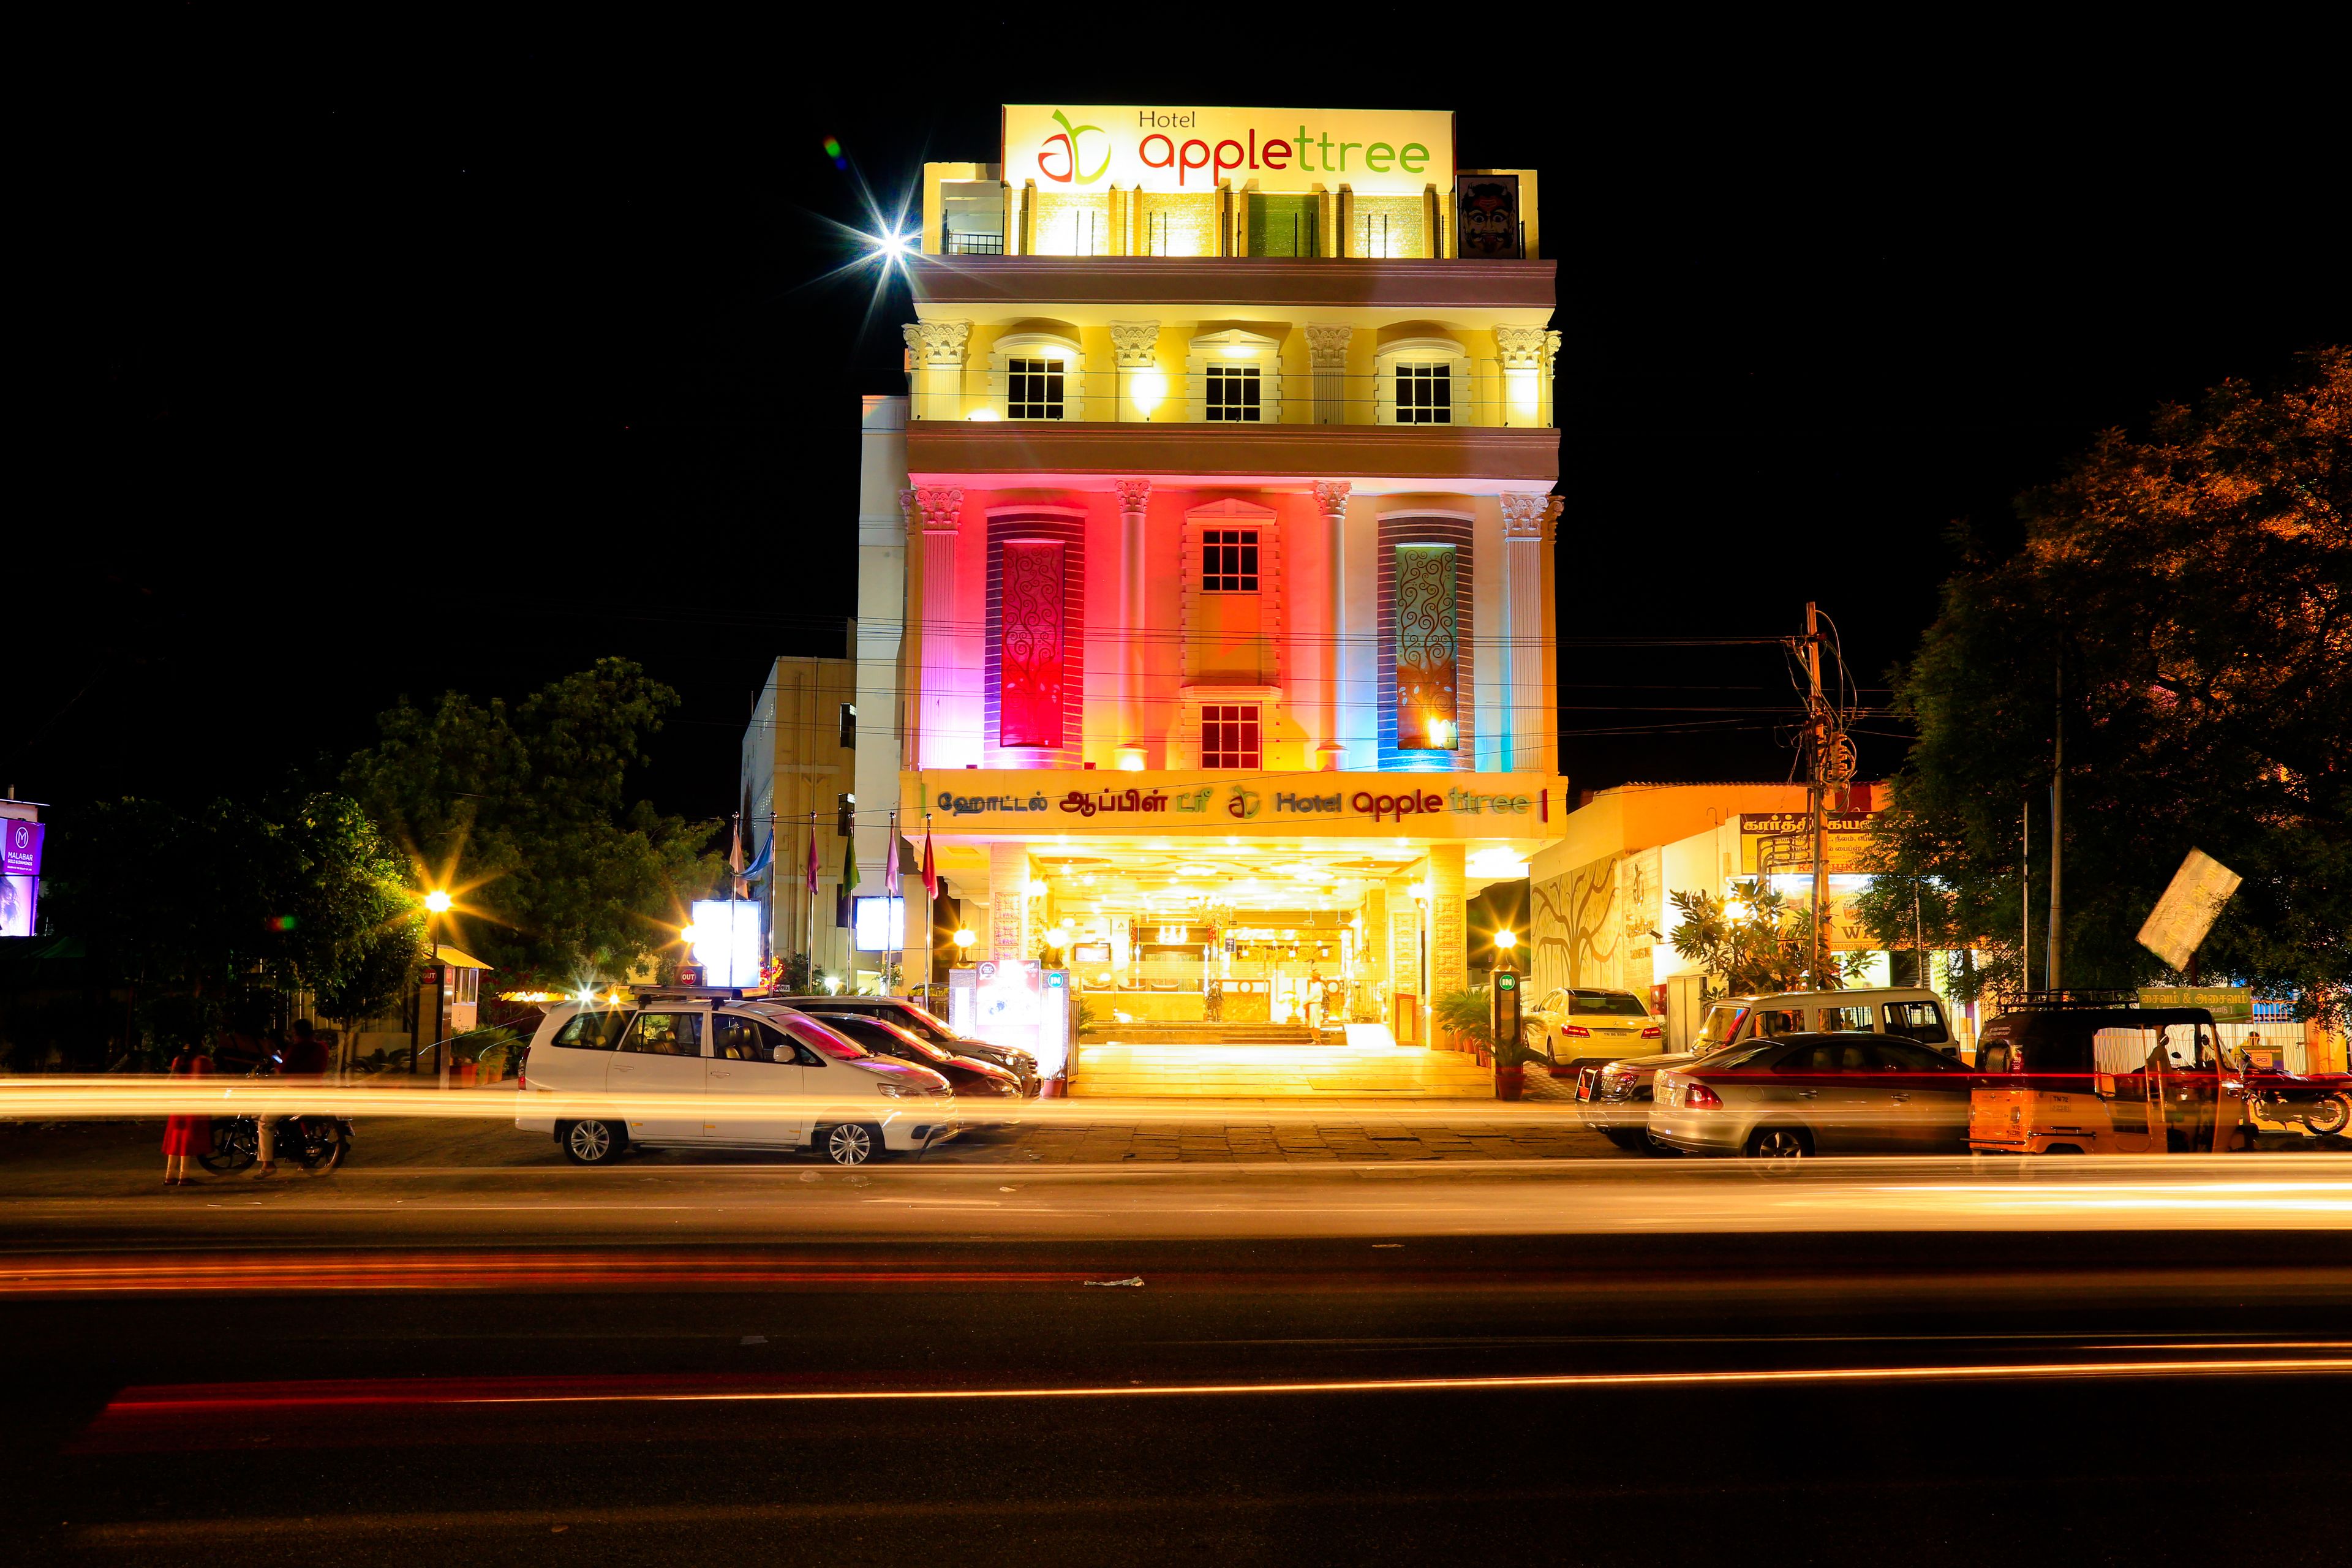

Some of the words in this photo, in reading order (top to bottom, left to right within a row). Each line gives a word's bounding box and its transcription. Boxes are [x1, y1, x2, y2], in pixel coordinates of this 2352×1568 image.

[1139, 111, 1196, 128] Hotel
[938, 791, 1048, 816] ஹோட்டல்
[1059, 788, 1168, 817] ஆப்பிள்
[1276, 792, 1341, 813] Hotel
[8, 851, 33, 861] MALABAR
[2141, 990, 2180, 1004] சைவம்
[2183, 993, 2191, 1003] &
[2195, 990, 2248, 1005] அசைவம்
